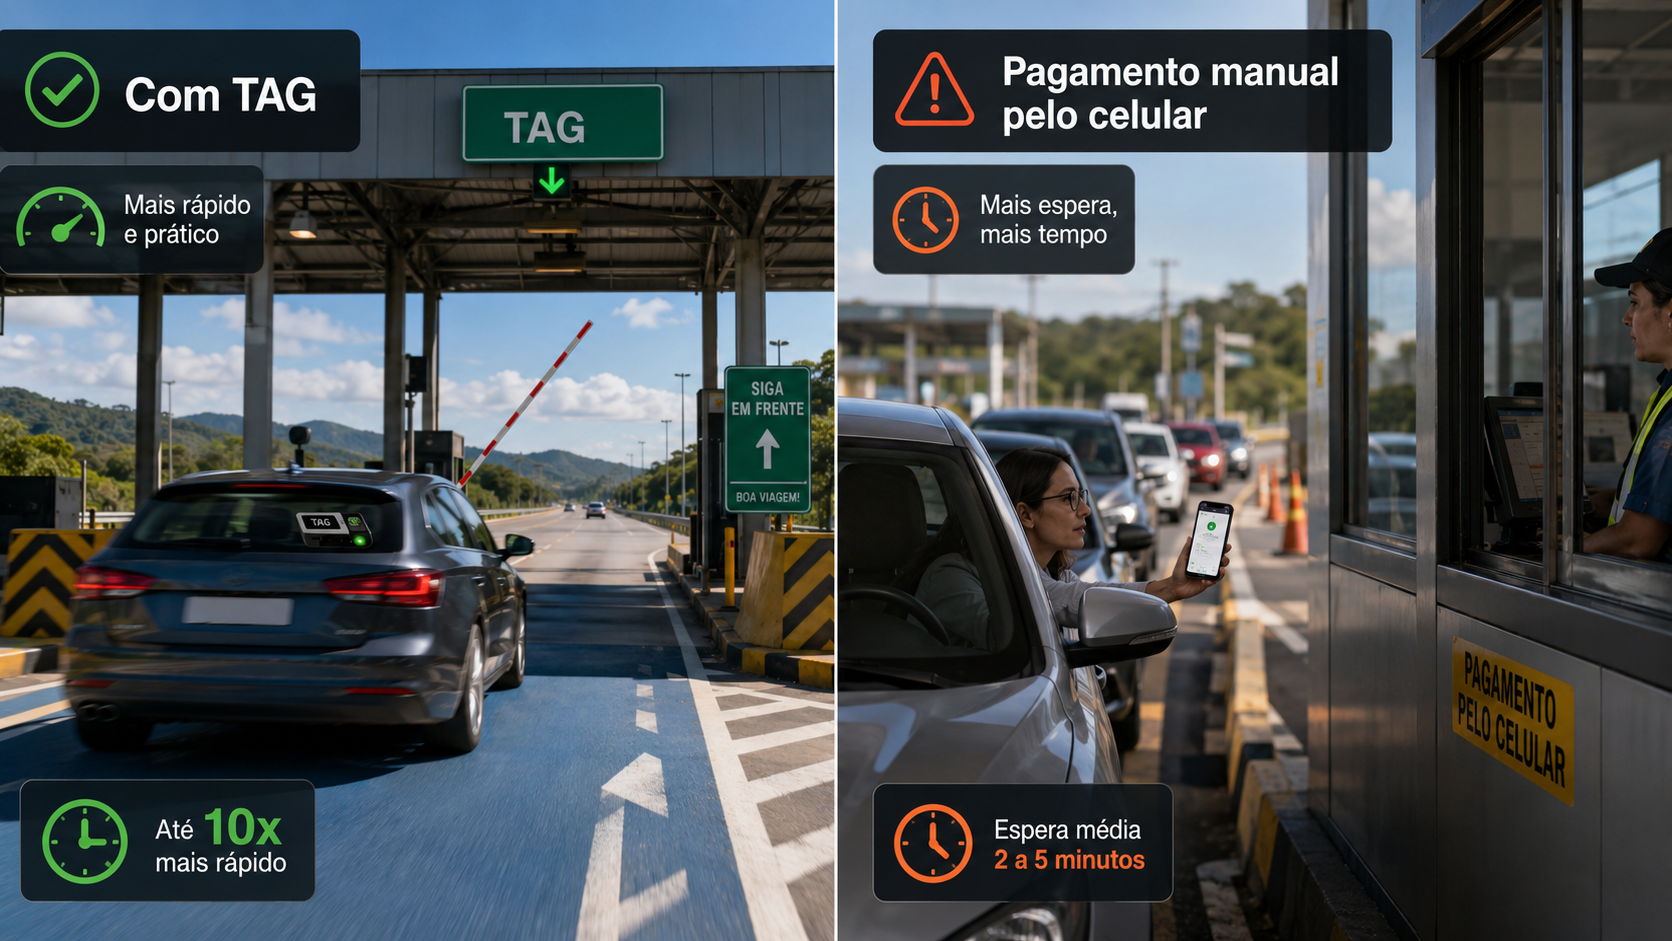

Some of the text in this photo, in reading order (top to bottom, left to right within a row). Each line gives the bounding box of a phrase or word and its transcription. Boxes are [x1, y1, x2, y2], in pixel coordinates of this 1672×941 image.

[504, 111, 585, 143] TAG
[751, 381, 784, 396] SIGA
[731, 401, 804, 415] EM FRENTE
[736, 492, 800, 503] BOA VIAGEM!
[310, 518, 331, 527] TAG
[1465, 651, 1556, 729] PAGAMENTO
[1458, 692, 1566, 788] PELO CELULAR
